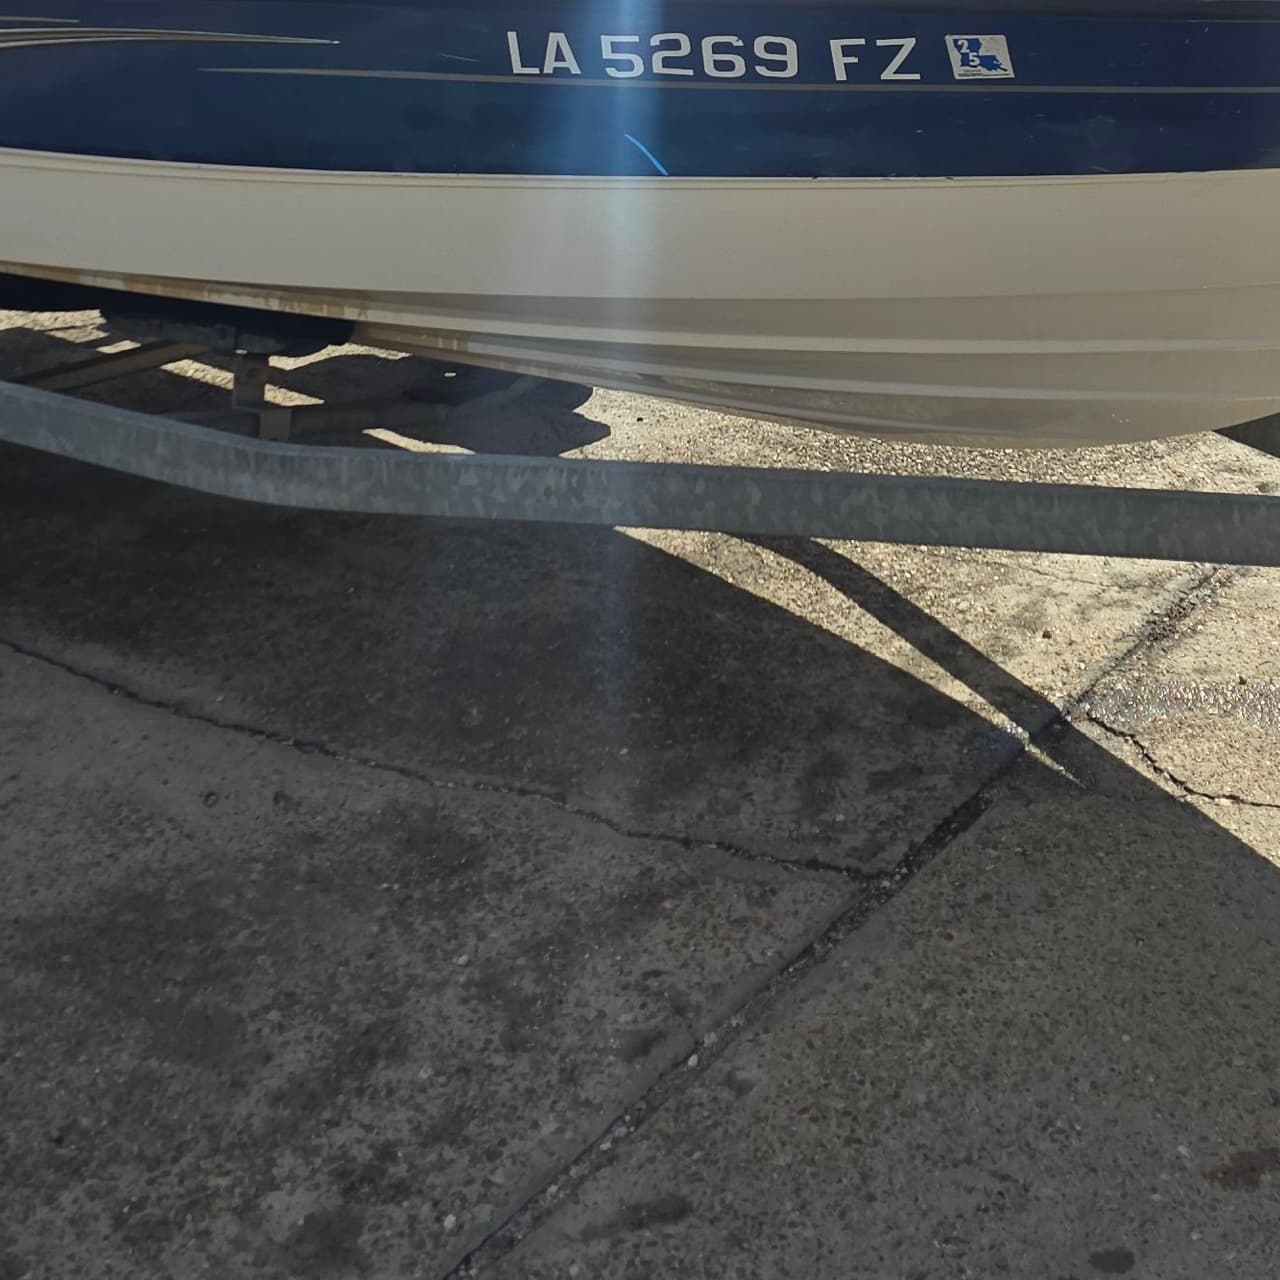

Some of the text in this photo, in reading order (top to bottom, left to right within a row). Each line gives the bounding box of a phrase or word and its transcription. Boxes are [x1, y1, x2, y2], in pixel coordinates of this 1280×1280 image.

[957, 39, 970, 53] 2
[506, 31, 921, 81] LA 5269 FZ
[968, 52, 980, 66] 5
